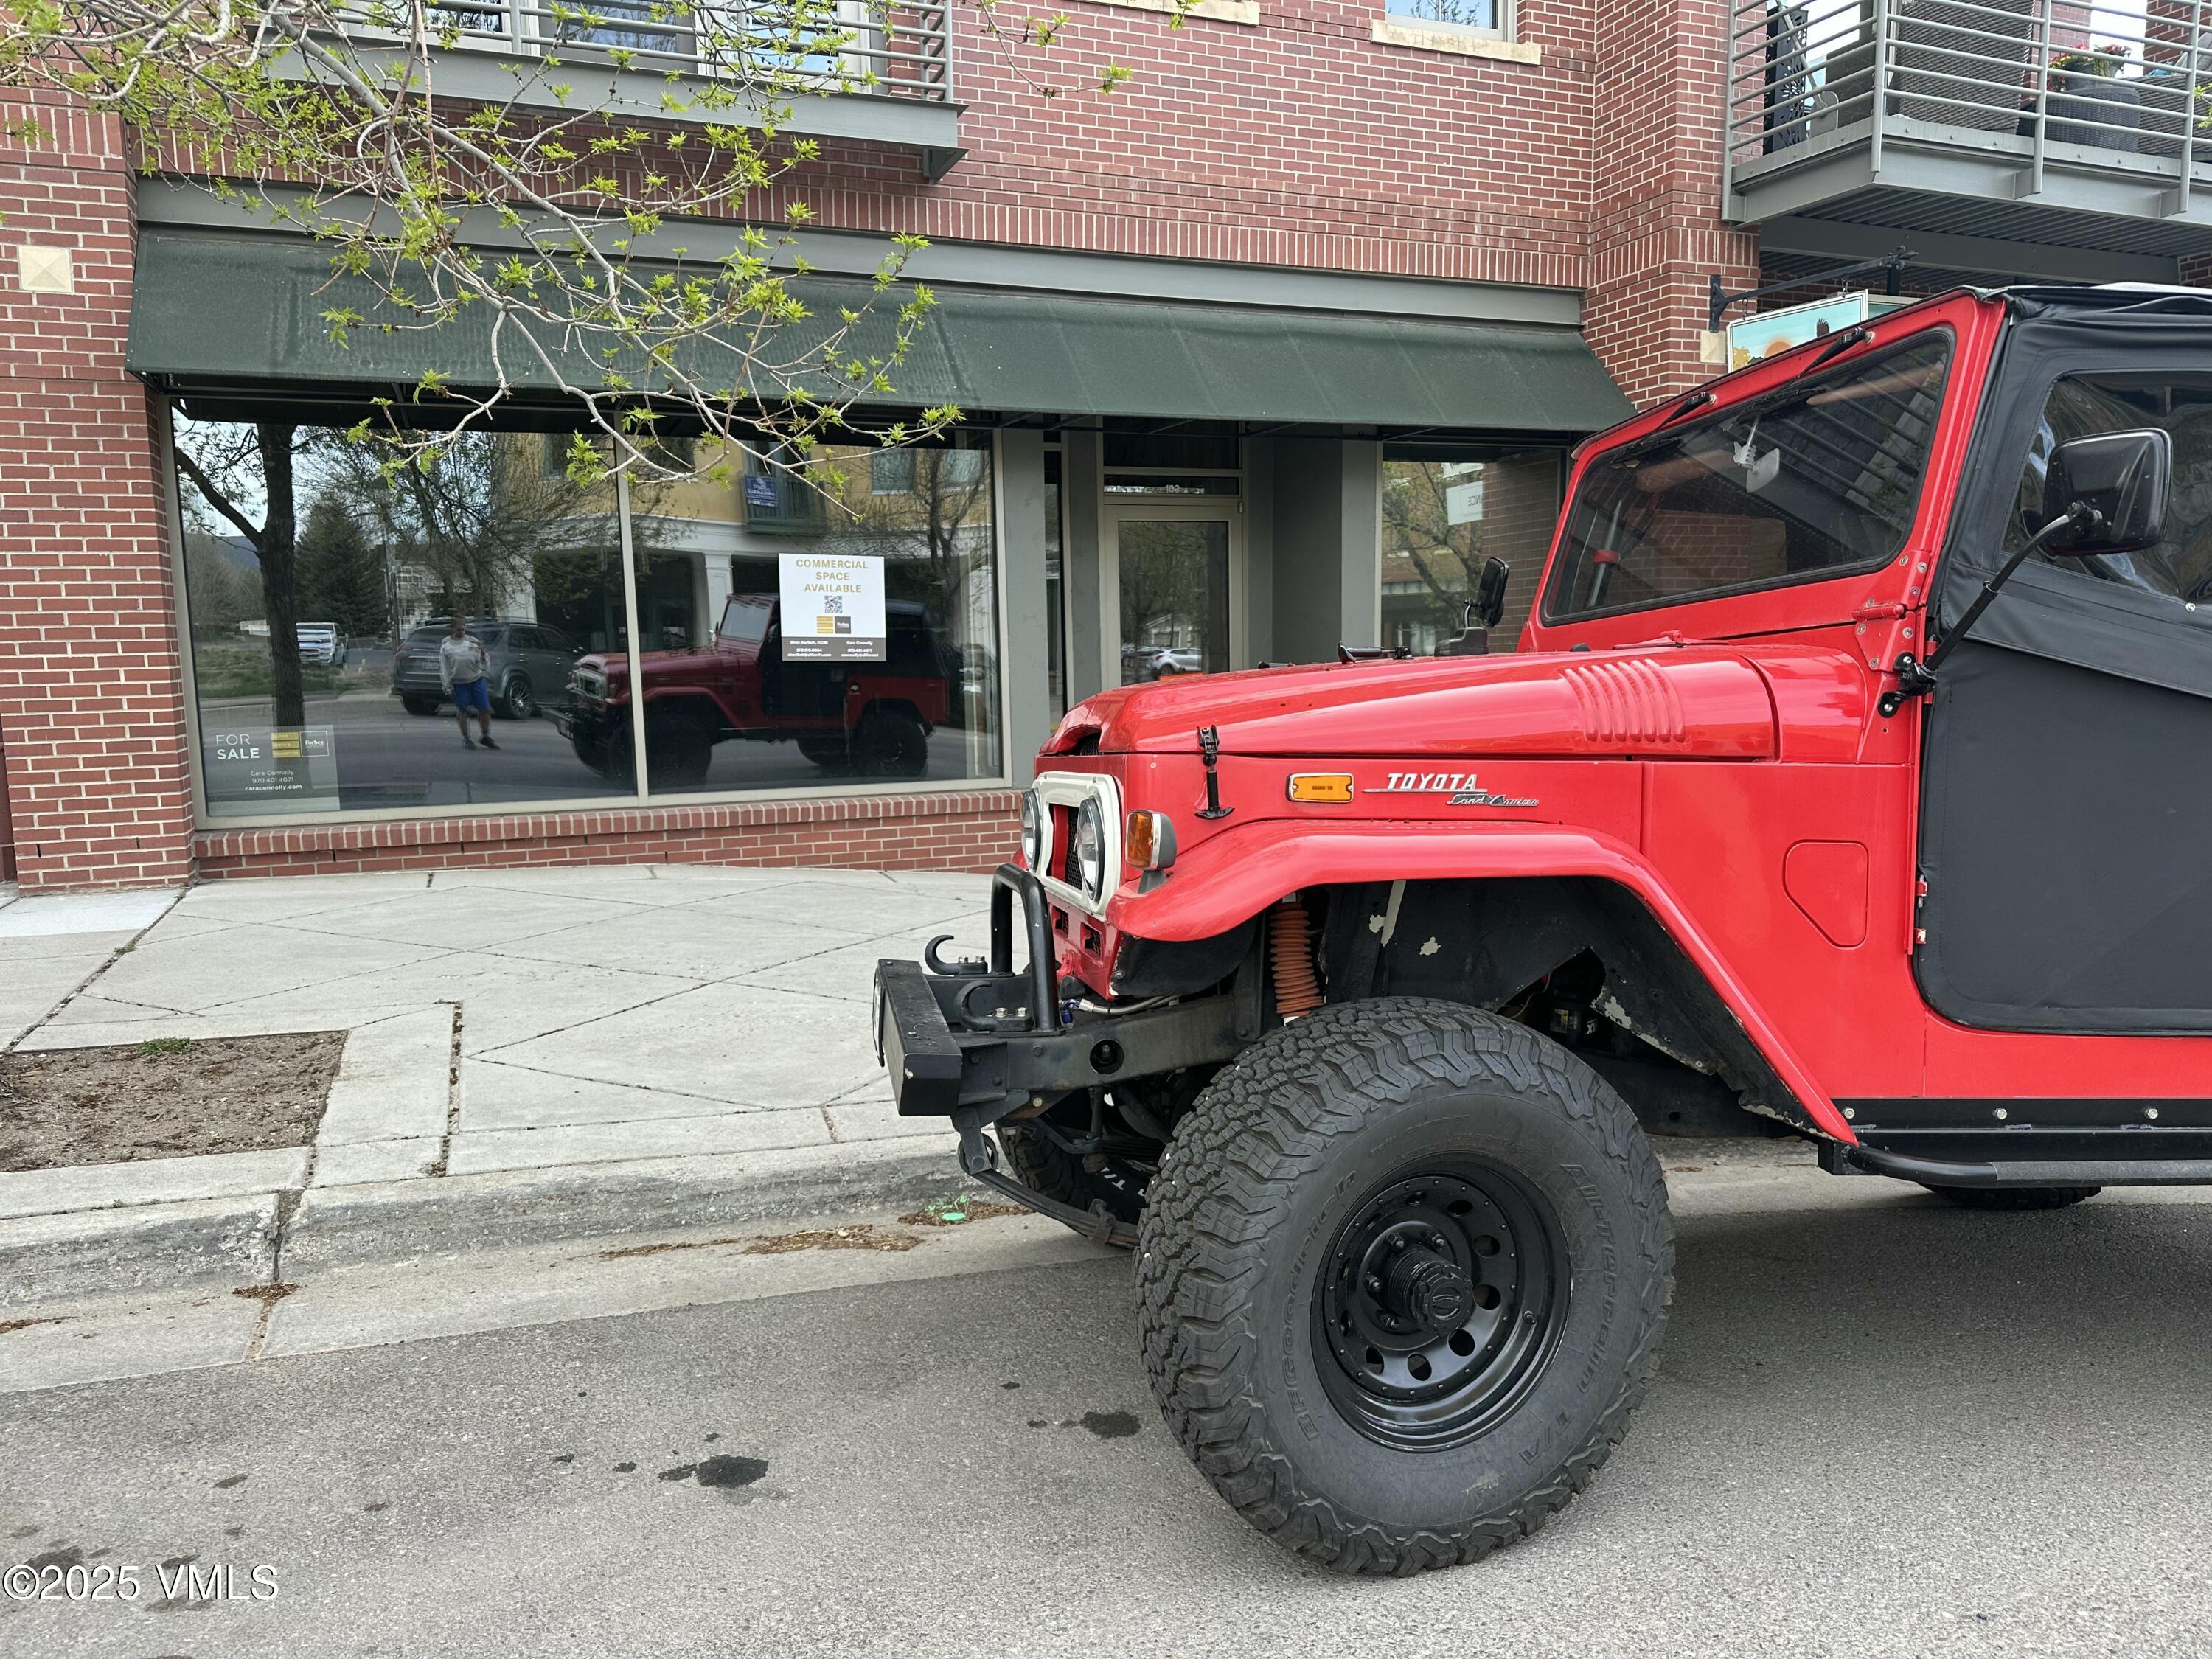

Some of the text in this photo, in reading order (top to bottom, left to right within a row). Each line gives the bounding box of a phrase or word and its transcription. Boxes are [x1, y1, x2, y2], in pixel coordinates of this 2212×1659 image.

[796, 559, 869, 569] COMMERCIAL
[815, 572, 849, 580] SPACE
[804, 583, 862, 593] AVAILABLE
[215, 734, 251, 746] FOR
[217, 748, 260, 760] SALE
[1387, 773, 1478, 790] TOYOTA
[1447, 793, 1488, 806] Land
[1559, 1164, 1617, 1393] All-Terrain
[1282, 1170, 1357, 1441] BFGoodrich
